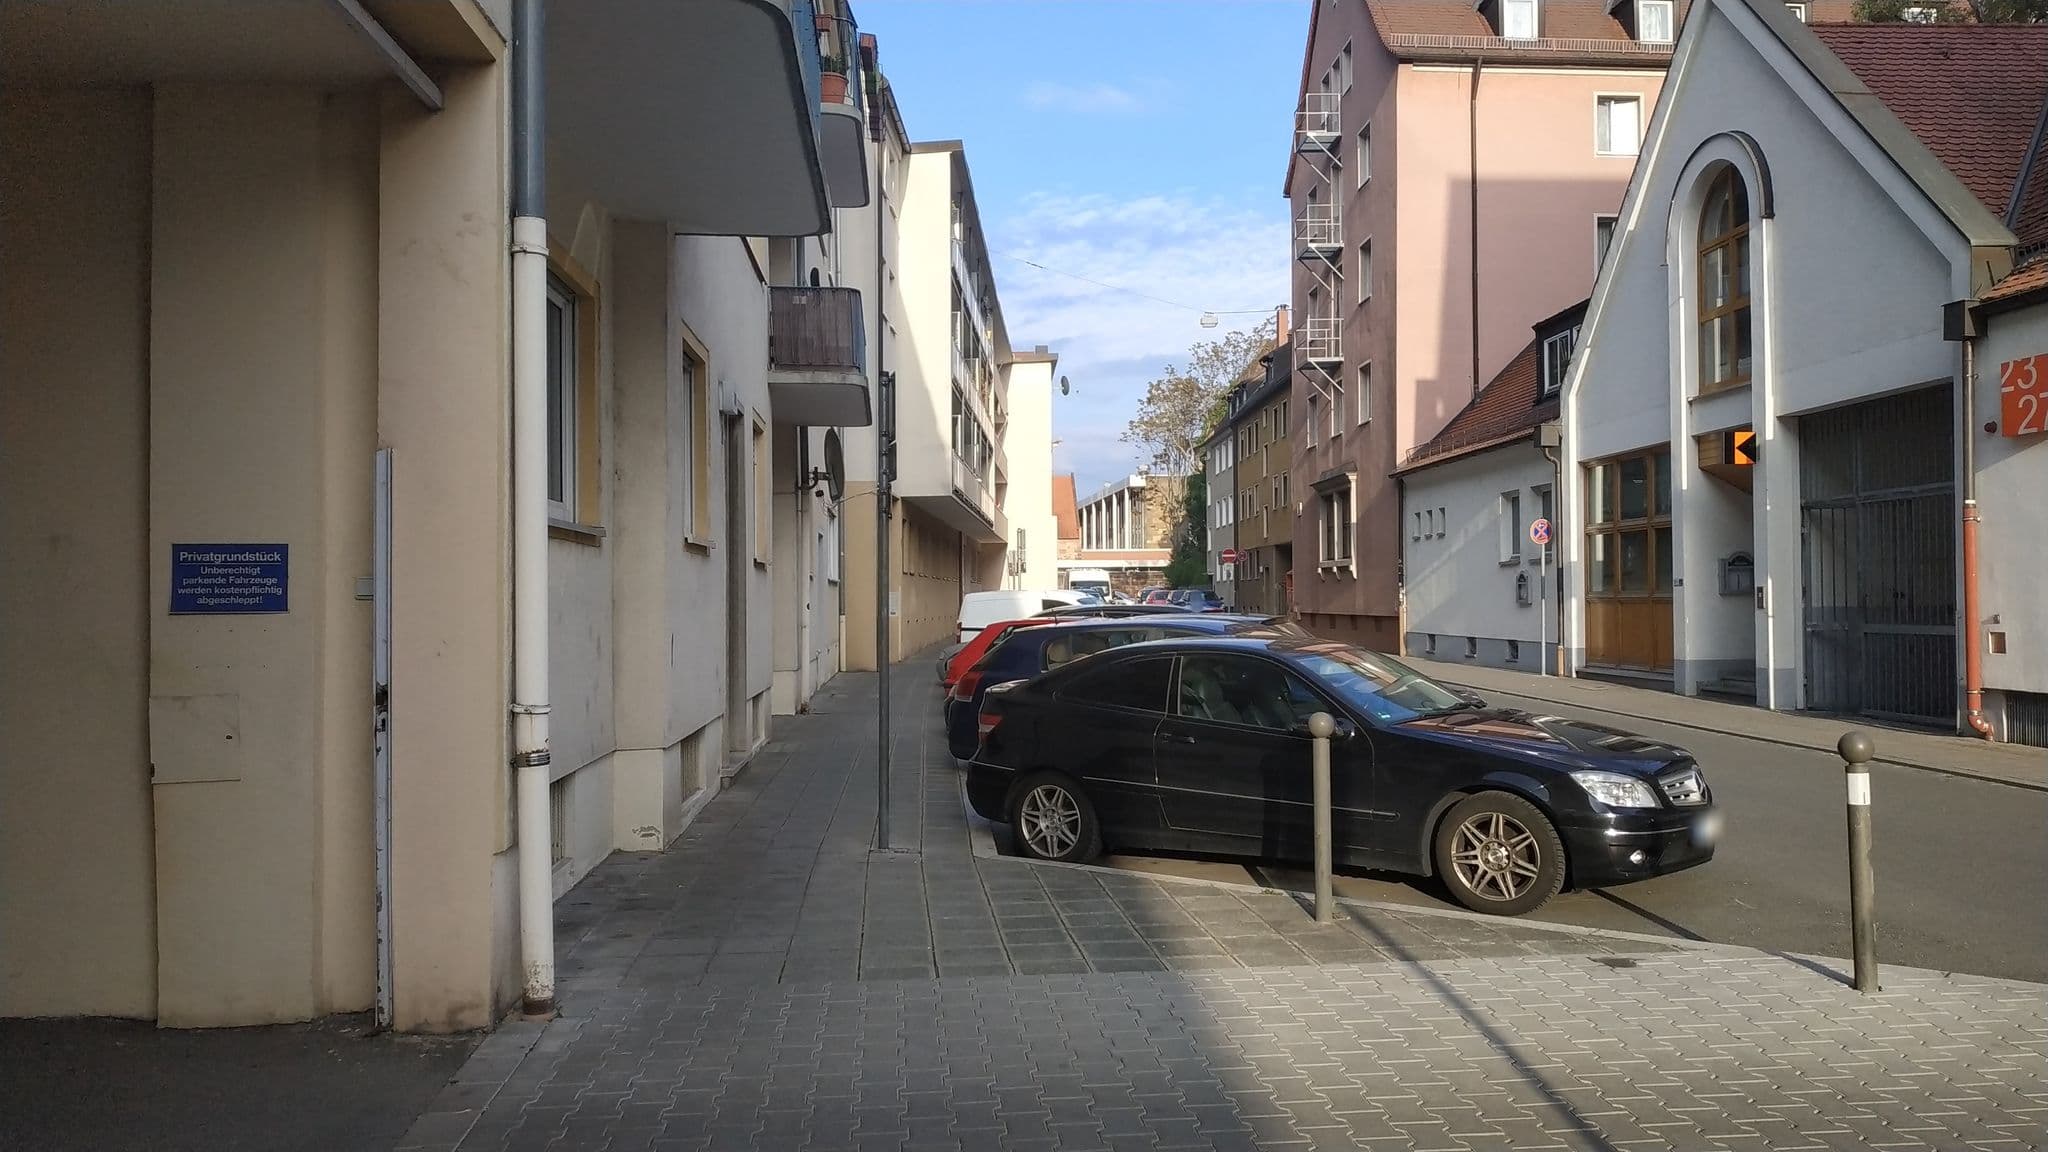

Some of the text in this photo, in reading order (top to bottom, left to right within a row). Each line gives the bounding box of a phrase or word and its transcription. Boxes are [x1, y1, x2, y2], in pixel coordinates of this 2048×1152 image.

[180, 551, 281, 563] Privatgrundstück
[200, 566, 261, 575] Unberechtigt
[183, 576, 278, 585] parkende Fahrzeuge
[178, 586, 282, 595] werden kostenpflichtig
[197, 596, 263, 605] abgeschleppt!
